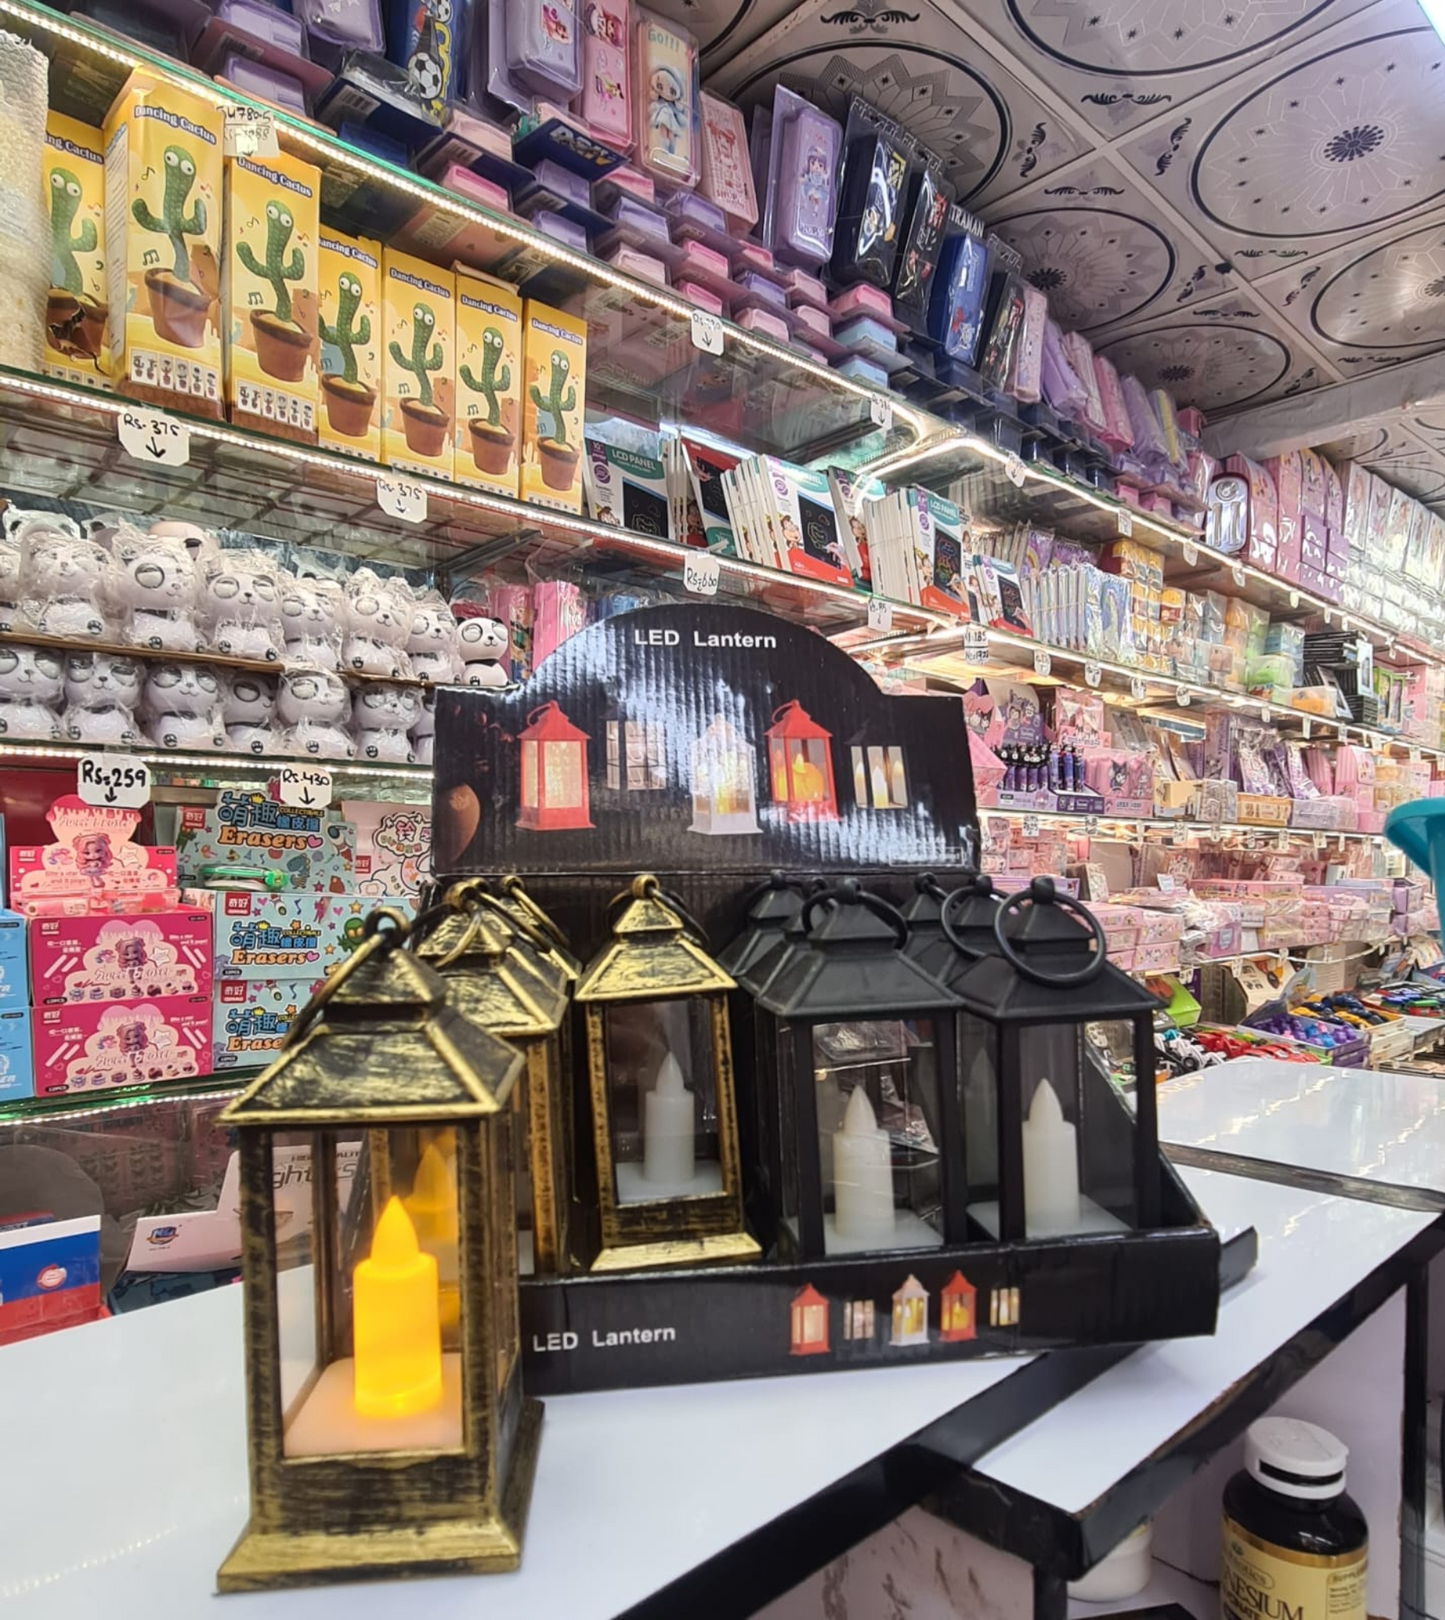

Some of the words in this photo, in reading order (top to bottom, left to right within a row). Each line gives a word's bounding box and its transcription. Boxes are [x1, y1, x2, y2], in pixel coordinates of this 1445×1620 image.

[134, 105, 178, 128] Dancing
[179, 116, 216, 145] Cactus
[65, 139, 104, 164] Cactus
[237, 157, 279, 184] Dancing
[280, 173, 312, 198] Cactus
[950, 204, 985, 238] TRAMAN
[320, 237, 351, 258] ancing
[351, 247, 377, 269] Cactus
[389, 267, 423, 289] Dancing
[424, 281, 450, 298] Cactus
[461, 294, 493, 314] Dancing
[493, 304, 518, 322] Cactus
[531, 317, 560, 338] Dancing
[560, 330, 583, 345] Cactus
[611, 448, 629, 462] LCD
[629, 453, 656, 471] PANEL
[634, 629, 680, 646] LED
[693, 630, 777, 648] Lantern
[218, 825, 308, 850] Erasers
[230, 949, 306, 965] Erasers
[226, 1036, 284, 1052] Erase
[533, 1332, 578, 1352] LED
[592, 1327, 676, 1347] Lantern
